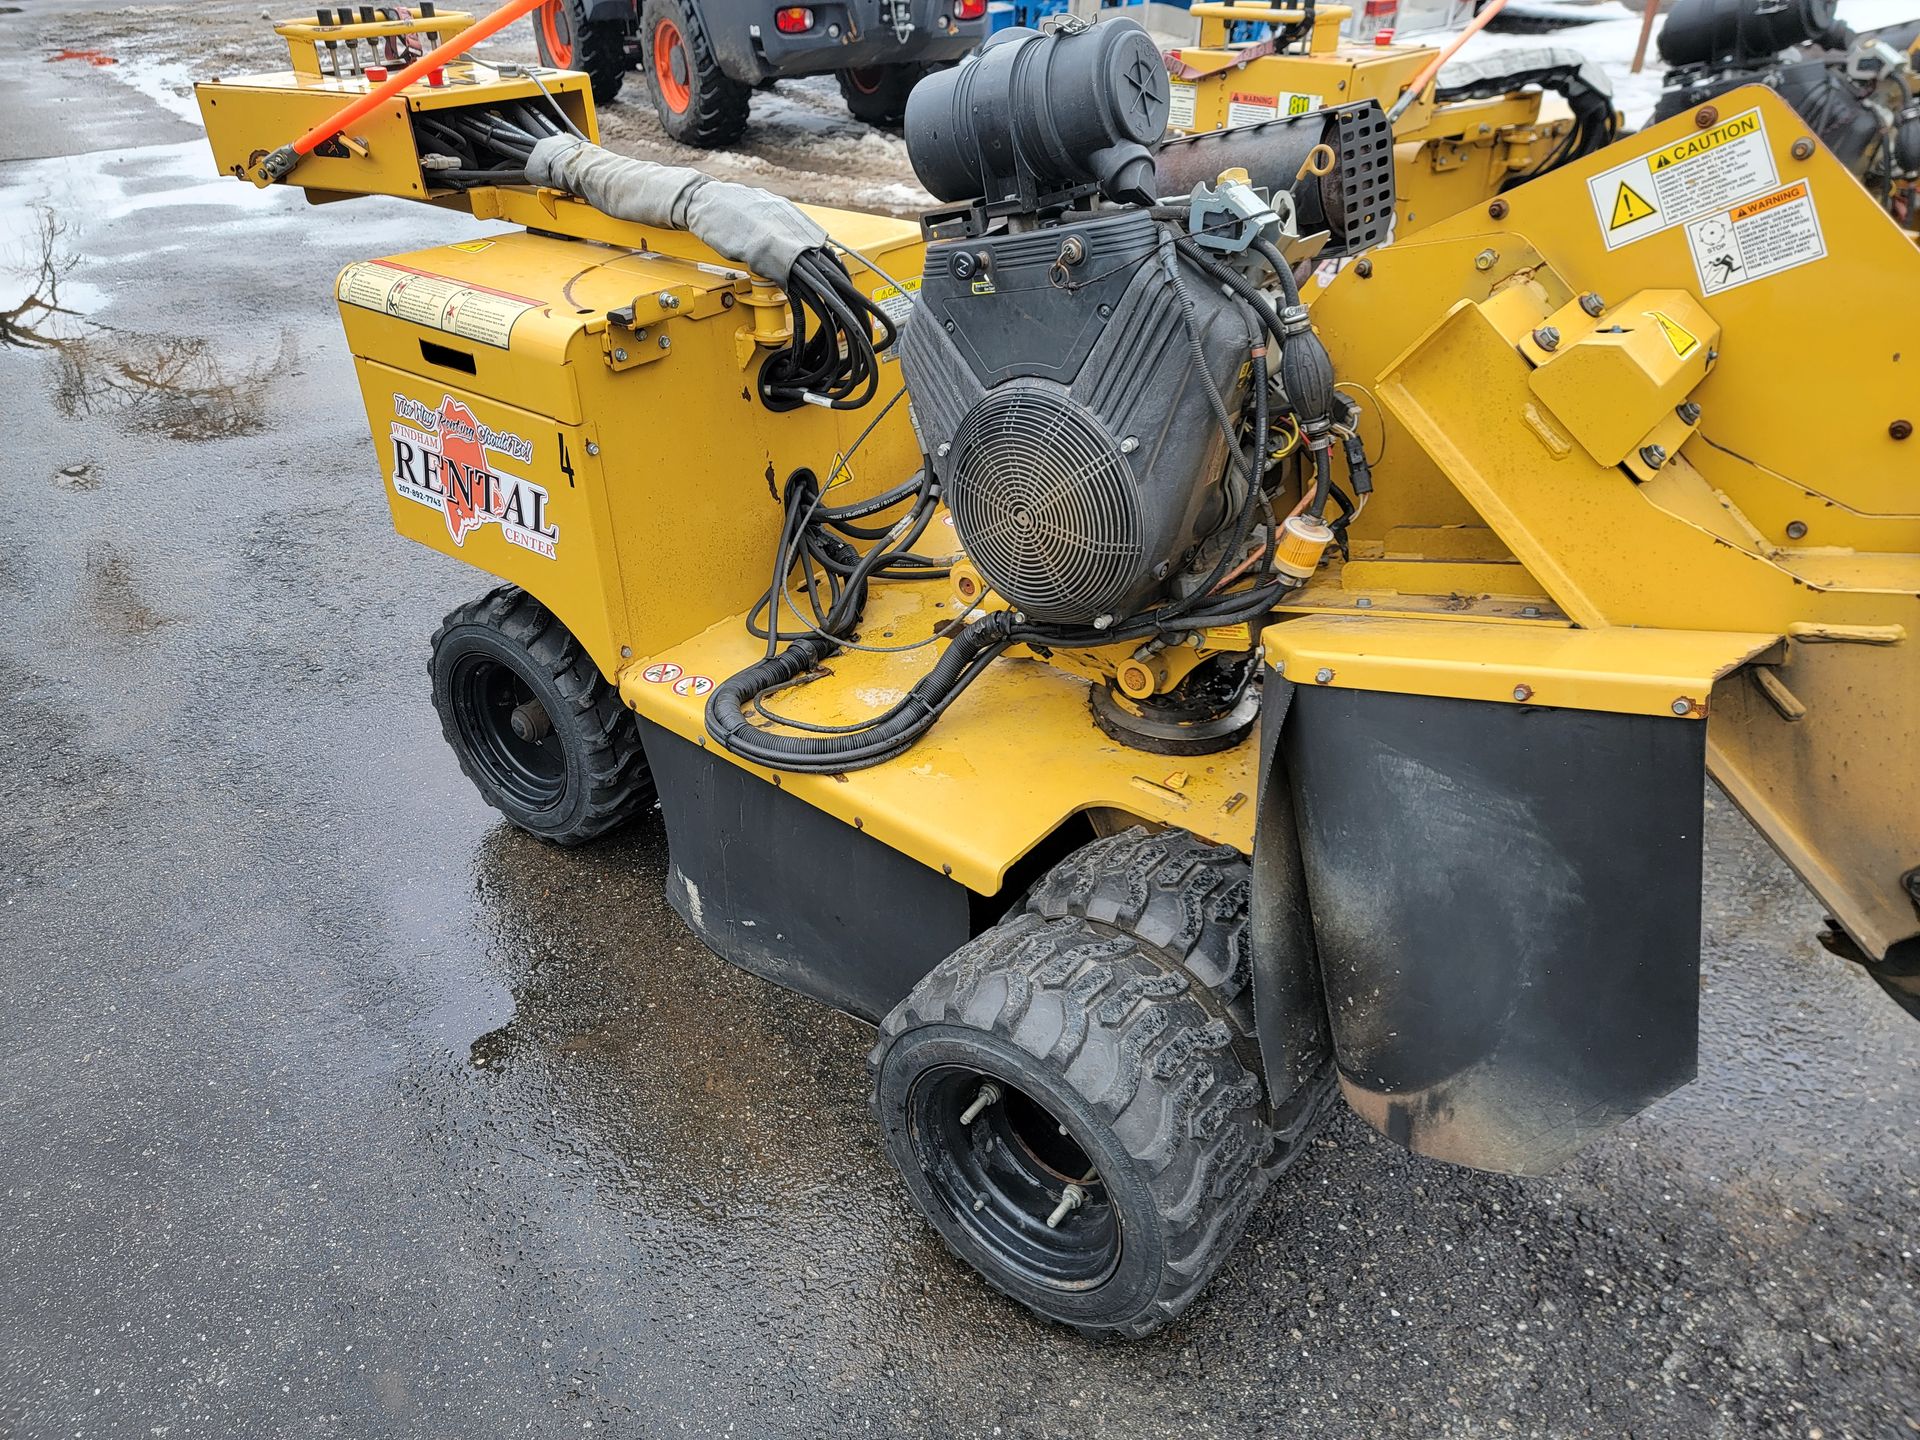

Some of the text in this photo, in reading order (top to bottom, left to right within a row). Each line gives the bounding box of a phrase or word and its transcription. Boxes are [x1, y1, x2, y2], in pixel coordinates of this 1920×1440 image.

[1243, 96, 1272, 104] WARNING
[1289, 95, 1310, 115] 811
[1674, 117, 1754, 160] CAUTION
[1701, 152, 1714, 160] BELT
[1728, 139, 1745, 149] CAUSE
[1657, 174, 1675, 184] ENGINE
[1676, 166, 1694, 176] CRANK
[1696, 159, 1711, 168] SHAFT
[1658, 177, 1681, 190] CORRECT
[1683, 167, 1705, 179] TENSION
[1736, 149, 1750, 158] YOUR
[1660, 182, 1682, 194] OWNER'S
[1684, 173, 1705, 185] MUAL.
[1708, 166, 1724, 175] BELTS
[1661, 188, 1684, 200] STRETCH
[1700, 173, 1720, 184] DURING
[1733, 162, 1748, 170] FIRST
[1696, 188, 1713, 198] CHECK
[1715, 178, 1737, 190] TENSION
[1739, 170, 1755, 180] EVERY
[1670, 192, 1687, 202] HOURS
[1670, 204, 1688, 214] HOURS
[1712, 188, 1727, 197] FIRST
[1748, 188, 1800, 212] WARNING
[1680, 207, 1694, 216] DAILY
[1759, 210, 1780, 221] SHIELDS
[1772, 209, 1800, 222] DISENGAGE
[1739, 230, 1756, 239] POWER
[1740, 232, 1767, 245] MOVEMENT
[1790, 217, 1809, 227] BEFORE
[1766, 232, 1798, 246] SPECTATORS
[1707, 243, 1726, 254] STOP
[1742, 238, 1767, 249] SERVICING
[1769, 245, 1794, 257] CLOTHING
[1772, 252, 1792, 261] MOVING
[392, 423, 438, 449] WINDHAM
[395, 396, 532, 462] The Way Renting Should Be!
[558, 432, 574, 488] 4
[392, 438, 558, 540] RENTAL
[398, 484, 442, 507] 207-892-7743
[506, 527, 554, 557] CENTER
